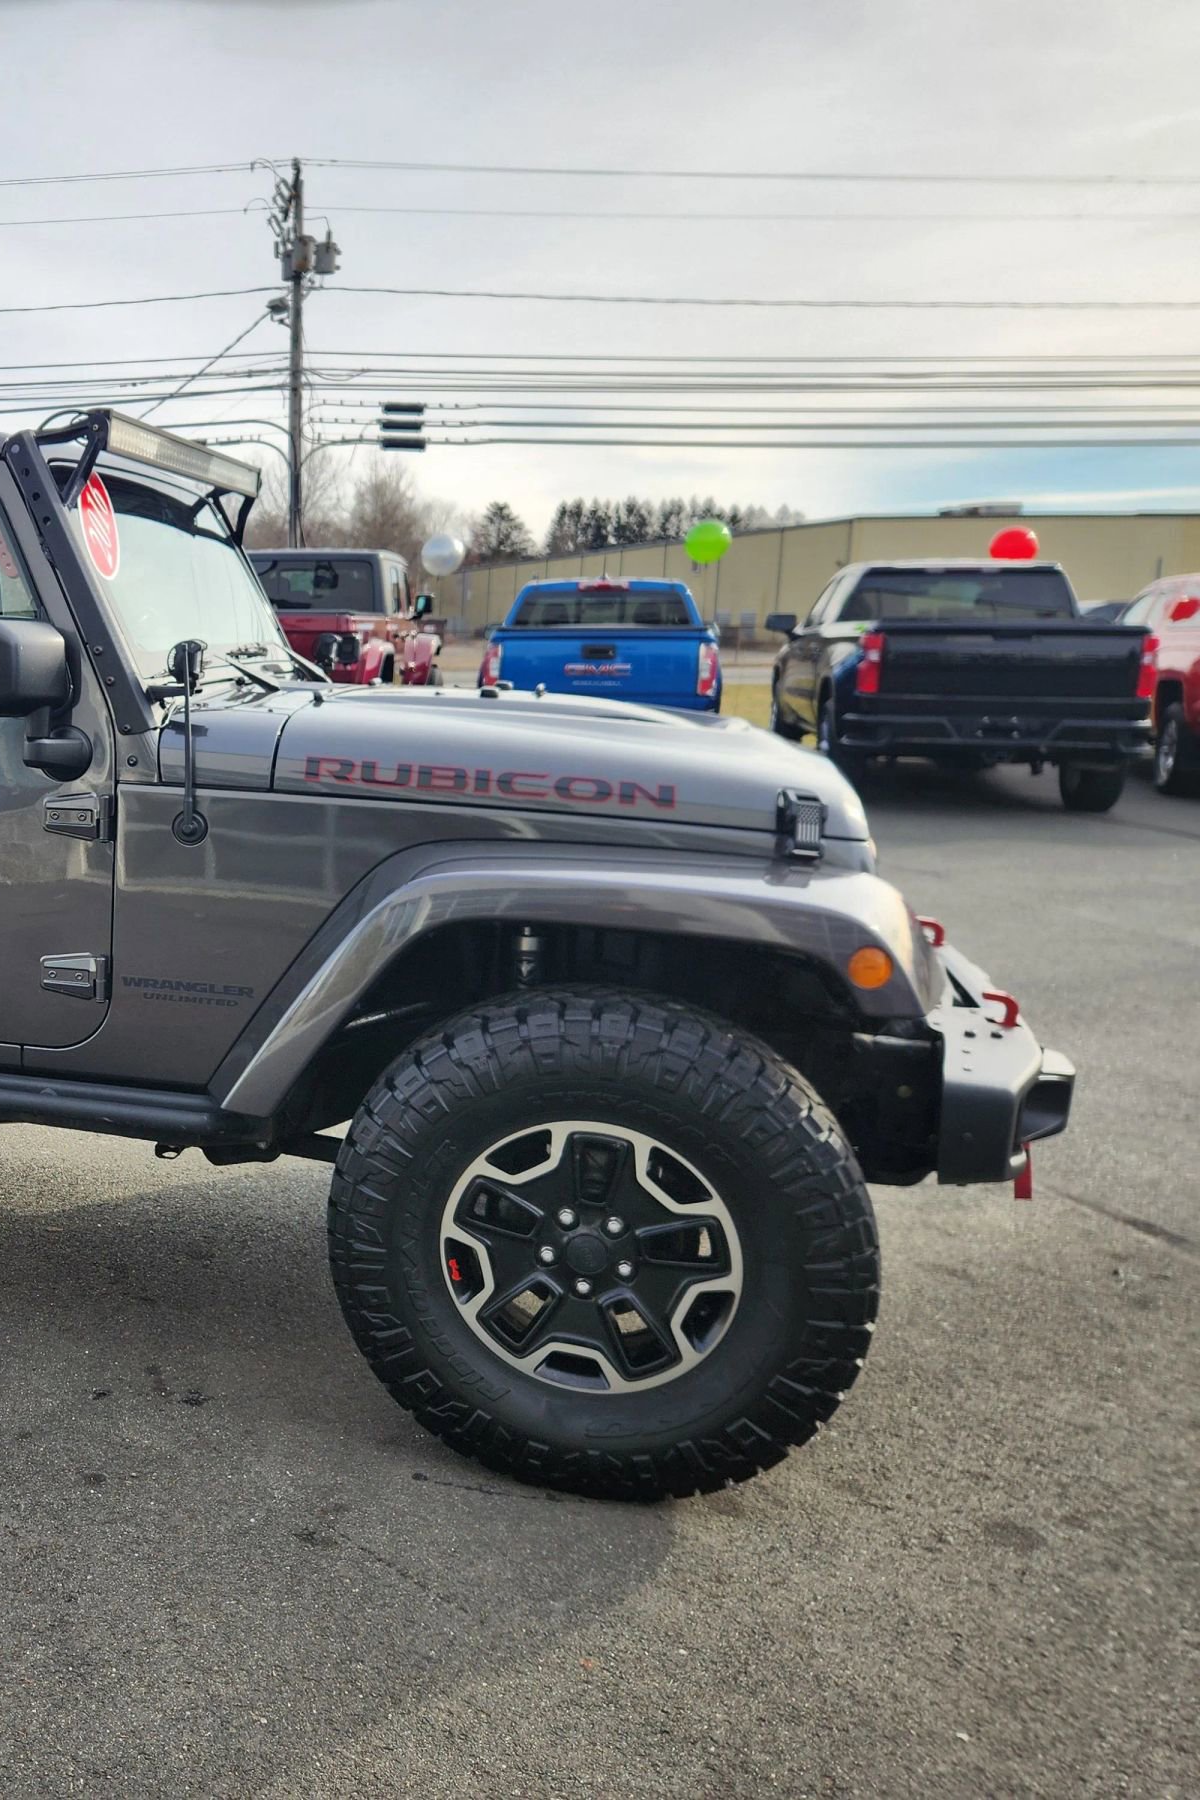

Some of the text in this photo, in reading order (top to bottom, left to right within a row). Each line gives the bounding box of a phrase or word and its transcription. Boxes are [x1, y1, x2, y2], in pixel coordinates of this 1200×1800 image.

[564, 662, 633, 677] GMC
[304, 755, 677, 810] RUBICON
[121, 976, 255, 998] WRANGLER
[143, 992, 239, 1008] UNLIMITED
